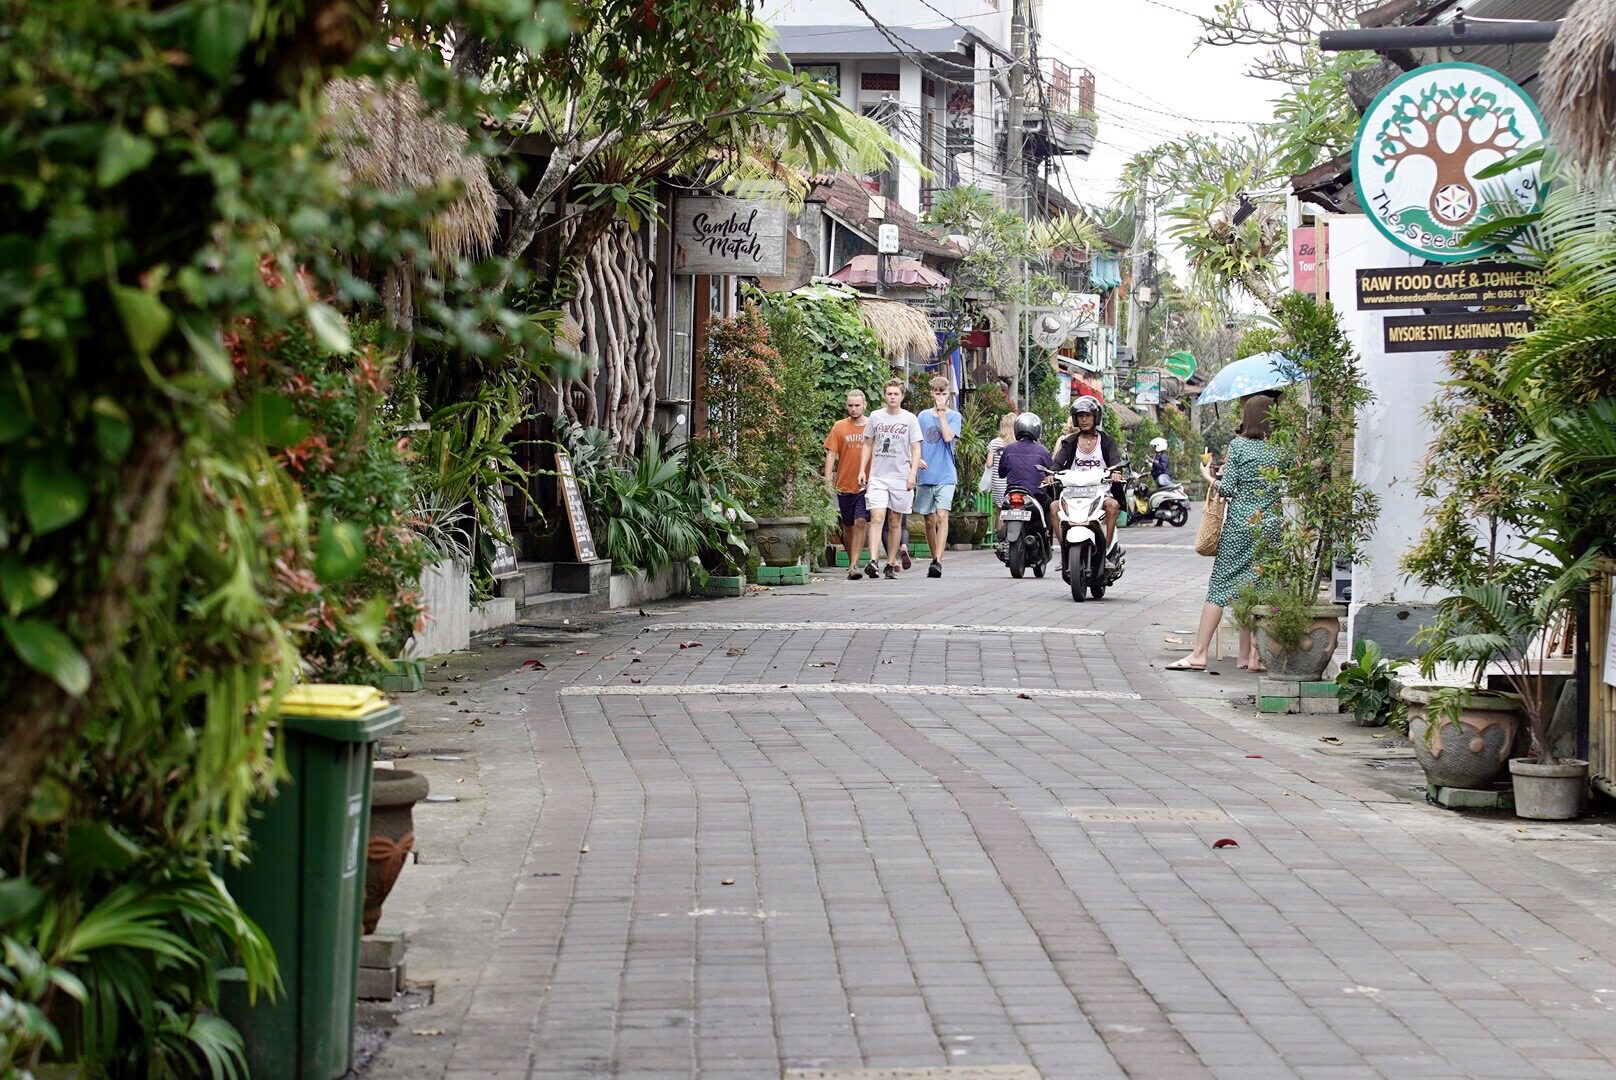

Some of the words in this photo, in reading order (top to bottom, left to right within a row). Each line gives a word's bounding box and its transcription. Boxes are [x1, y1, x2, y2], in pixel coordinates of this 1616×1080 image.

[1372, 188, 1401, 226] The
[692, 208, 758, 241] Sambal
[702, 232, 763, 262] Matah
[1361, 275, 1392, 292] RAW
[1394, 274, 1432, 290] FOOD
[1434, 270, 1467, 289] CAFÉ
[1469, 272, 1480, 286] &
[1482, 271, 1522, 287] TONIC
[1483, 291, 1497, 301] ph:
[1497, 289, 1518, 299] 0361
[1389, 326, 1426, 342] MYSORE
[1427, 325, 1453, 341] STYLE
[1454, 323, 1502, 339] ASHTANGA
[1503, 321, 1529, 337] YOGA
